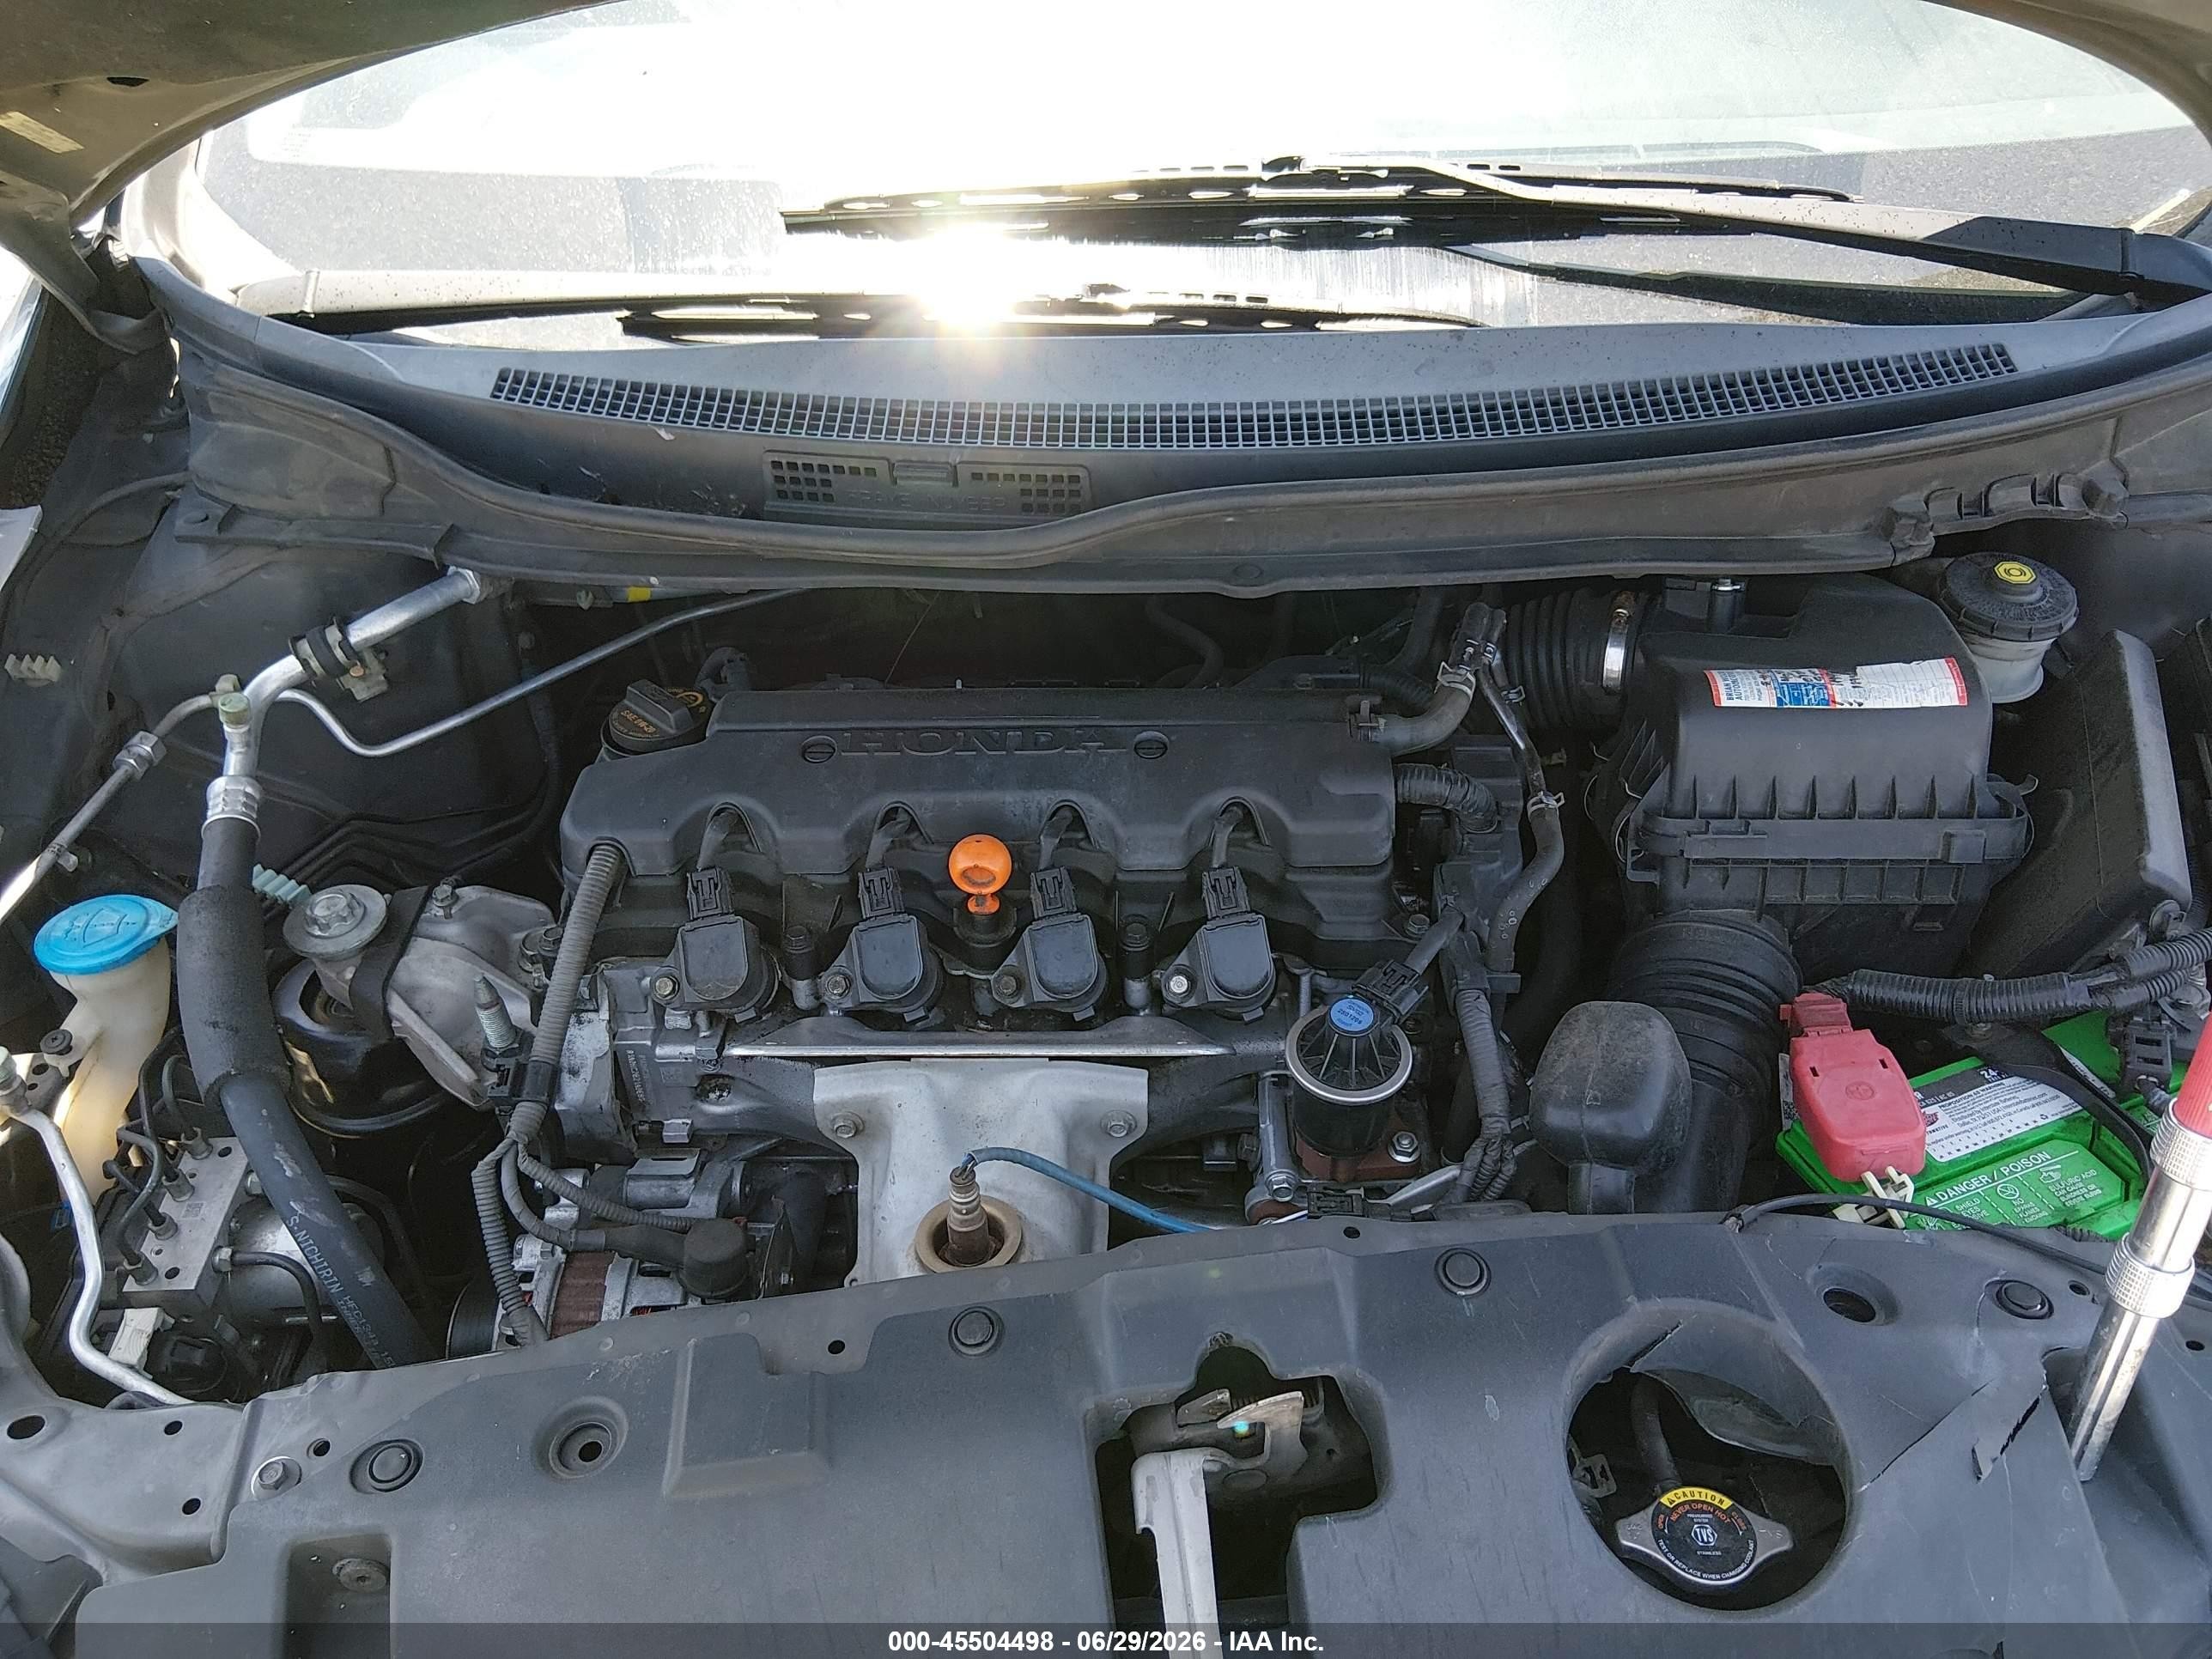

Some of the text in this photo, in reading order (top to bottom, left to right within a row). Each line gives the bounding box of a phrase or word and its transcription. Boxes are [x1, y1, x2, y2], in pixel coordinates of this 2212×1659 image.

[842, 732, 1127, 757] HONDA
[1936, 1174, 1992, 1201] DANGER
[2000, 1151, 2052, 1176] POISON
[1954, 1198, 1980, 1212] SHIELD
[1961, 1206, 1981, 1217] EYES
[1675, 1491, 1725, 1506] CAUTION
[1670, 1502, 1732, 1524] NEVER OPEN HOT
[1695, 1527, 1714, 1543] TVS
[1657, 1538, 1668, 1553] TEST
[1667, 1552, 1674, 1562] OR
[1674, 1559, 1702, 1577] REPLACE
